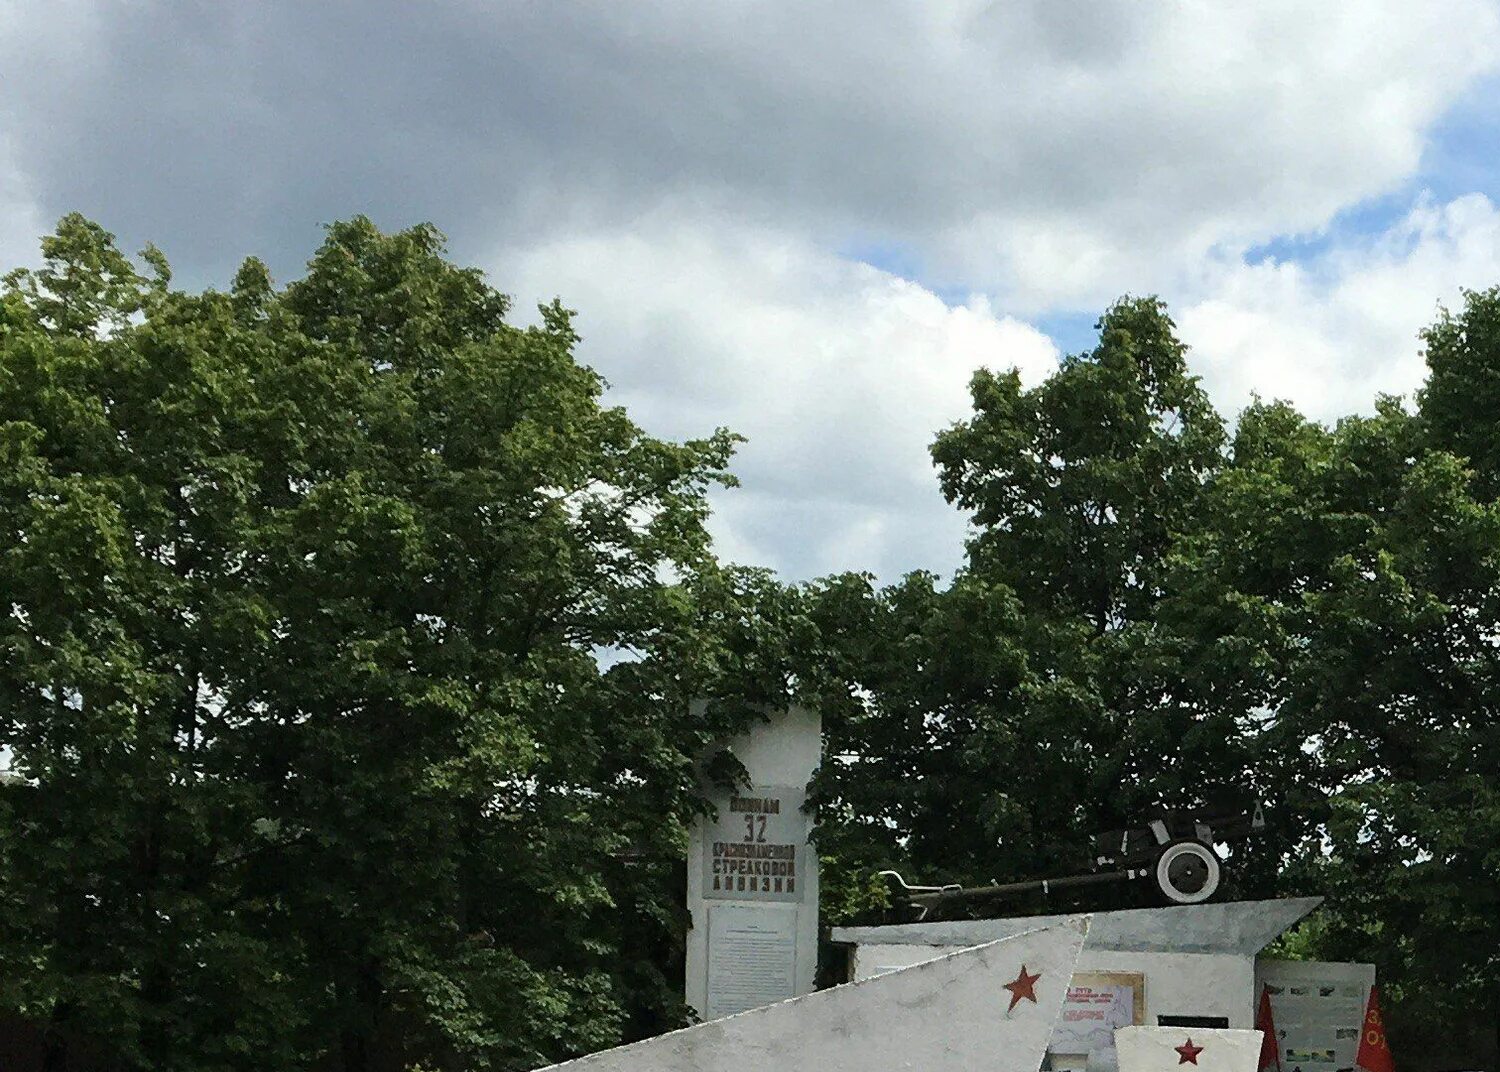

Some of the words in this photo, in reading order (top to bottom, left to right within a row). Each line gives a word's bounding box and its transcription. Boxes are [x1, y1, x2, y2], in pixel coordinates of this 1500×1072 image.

[744, 814, 767, 843] 32
[712, 859, 795, 876] СТРЕЛКОВОЙ
[712, 876, 795, 893] ДИВИЗИИ
